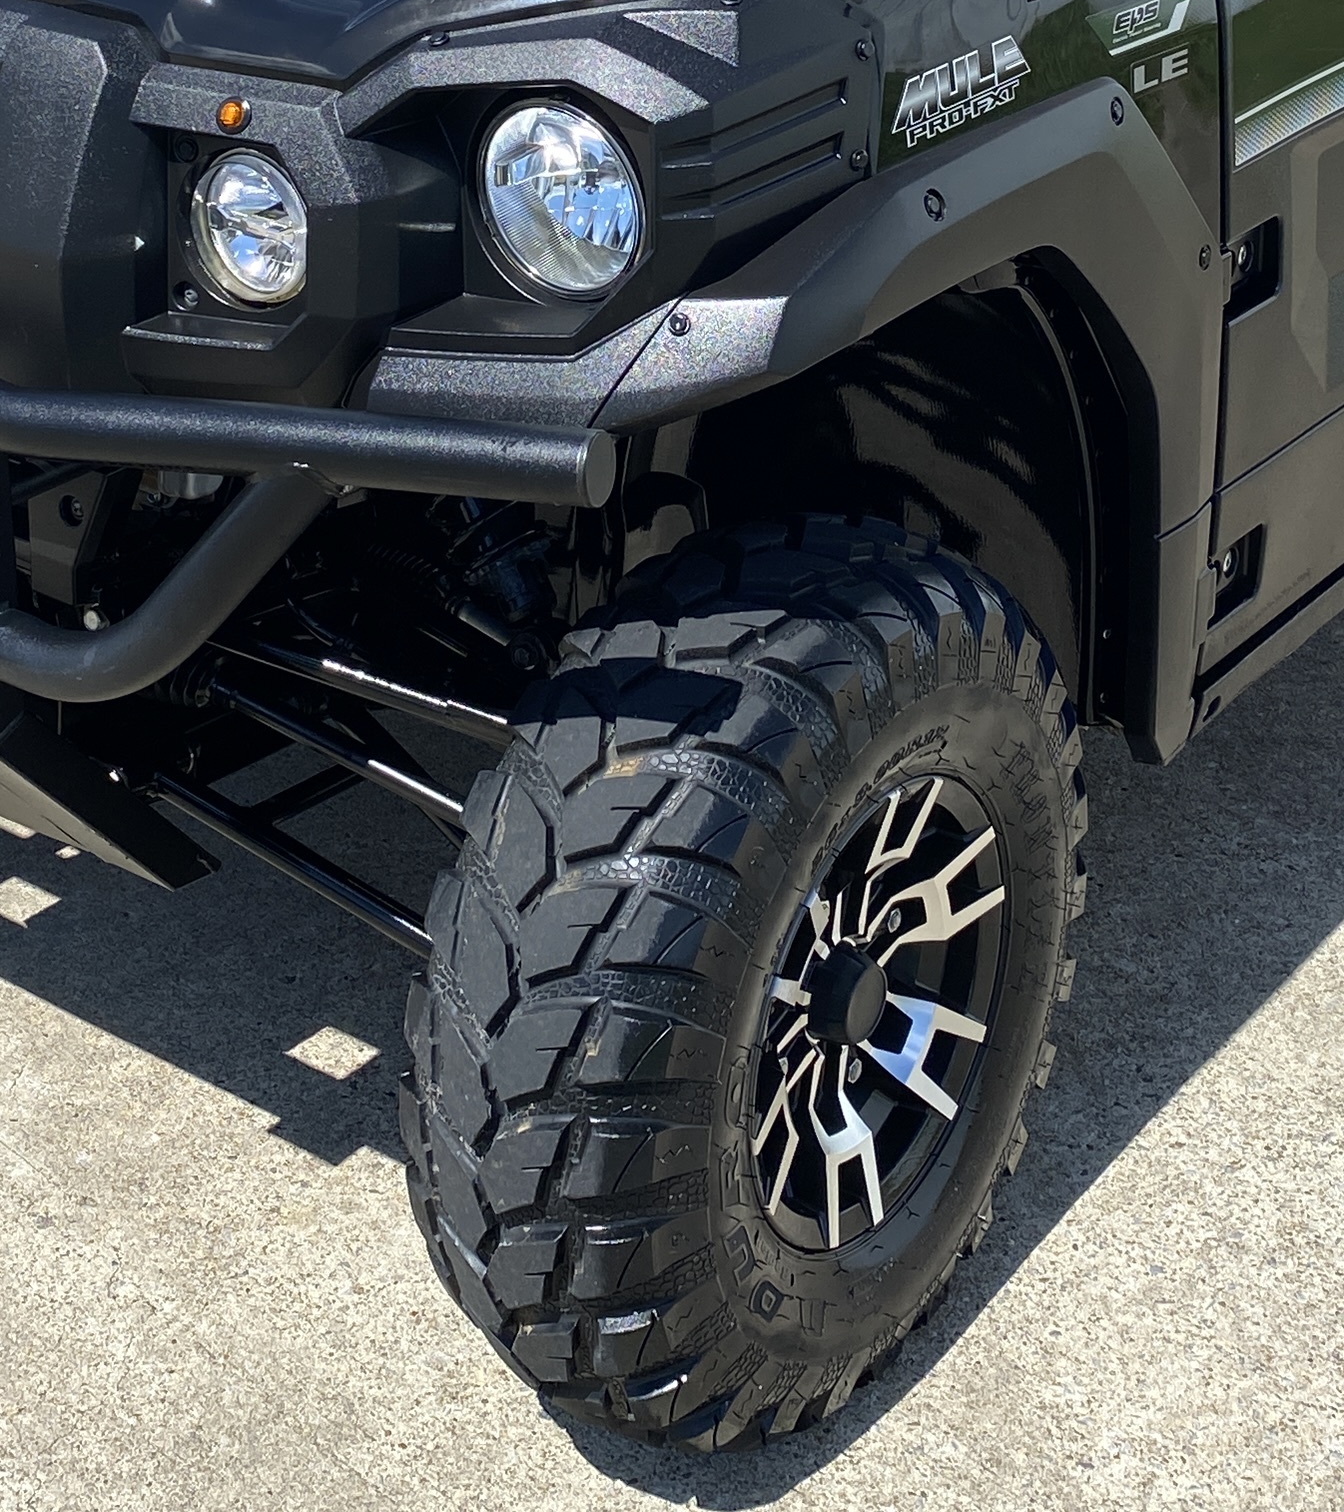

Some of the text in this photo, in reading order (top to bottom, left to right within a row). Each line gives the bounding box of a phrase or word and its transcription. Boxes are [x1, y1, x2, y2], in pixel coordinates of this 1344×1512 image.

[891, 34, 1032, 135] MULE
[1133, 48, 1189, 94] LE
[906, 78, 1020, 149] PRO-FXT
